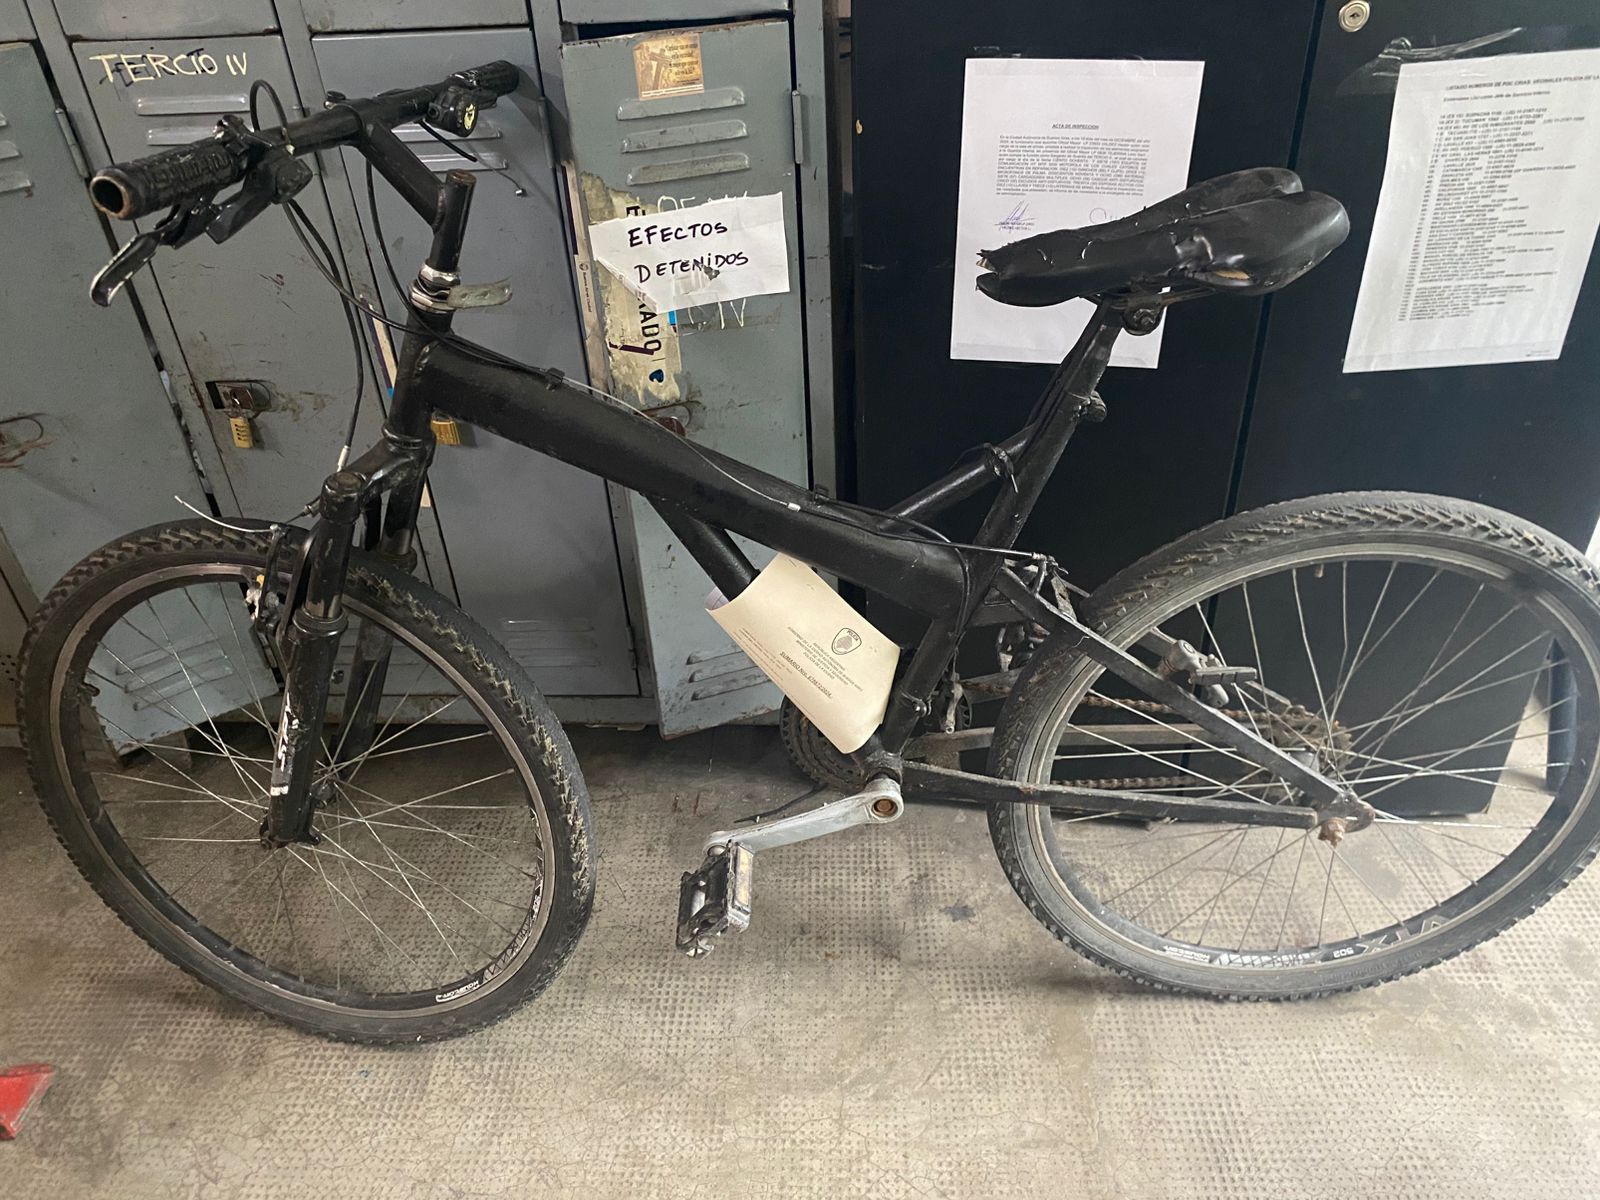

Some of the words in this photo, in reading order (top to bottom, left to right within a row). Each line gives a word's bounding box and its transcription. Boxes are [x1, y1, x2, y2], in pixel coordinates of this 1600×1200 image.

[89, 53, 218, 83] TERCIO
[225, 52, 247, 75] IV
[627, 221, 729, 248] EFECTOS
[634, 251, 749, 284] DETENIDOS
[846, 629, 860, 642] POLICIA
